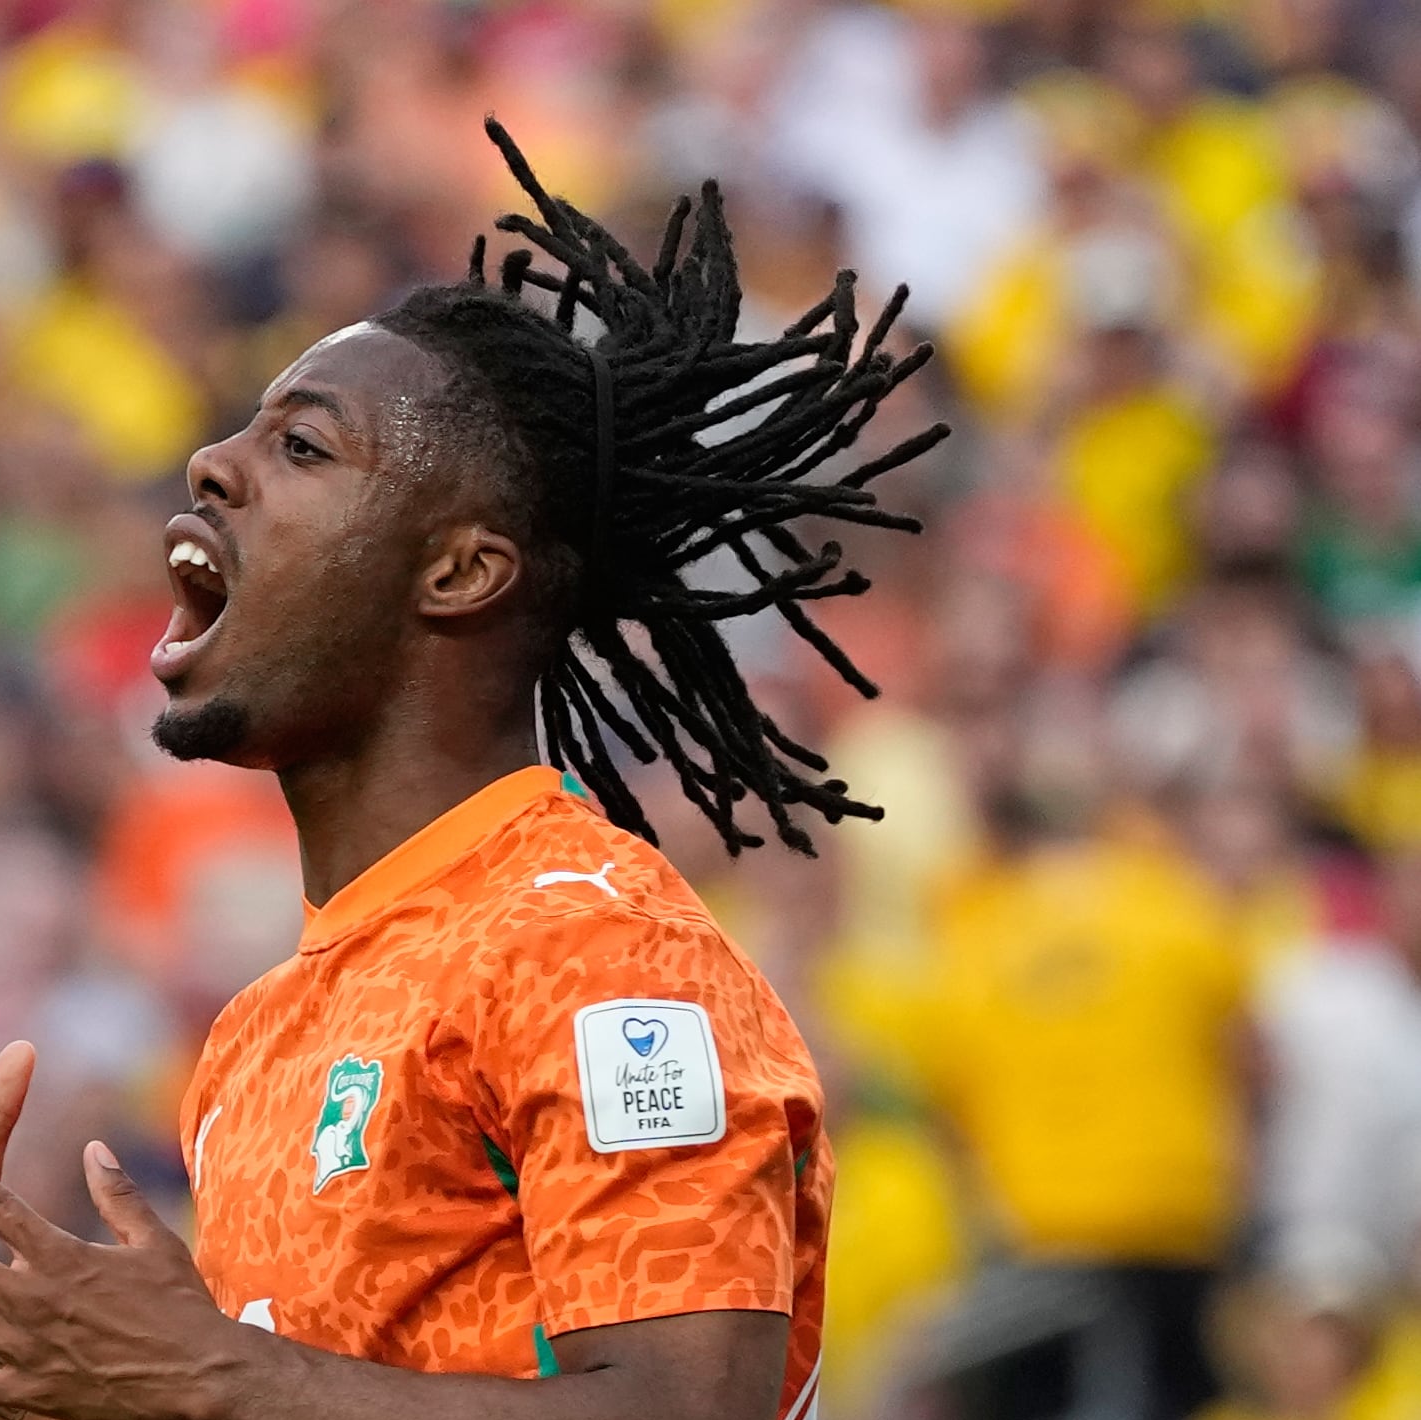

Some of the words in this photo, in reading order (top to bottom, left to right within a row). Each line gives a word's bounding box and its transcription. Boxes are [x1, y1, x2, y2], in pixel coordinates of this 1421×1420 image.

[615, 1063, 658, 1089] Unite
[660, 1060, 685, 1084] For
[622, 1086, 685, 1114] PEACE
[638, 1117, 672, 1130] FIFA
